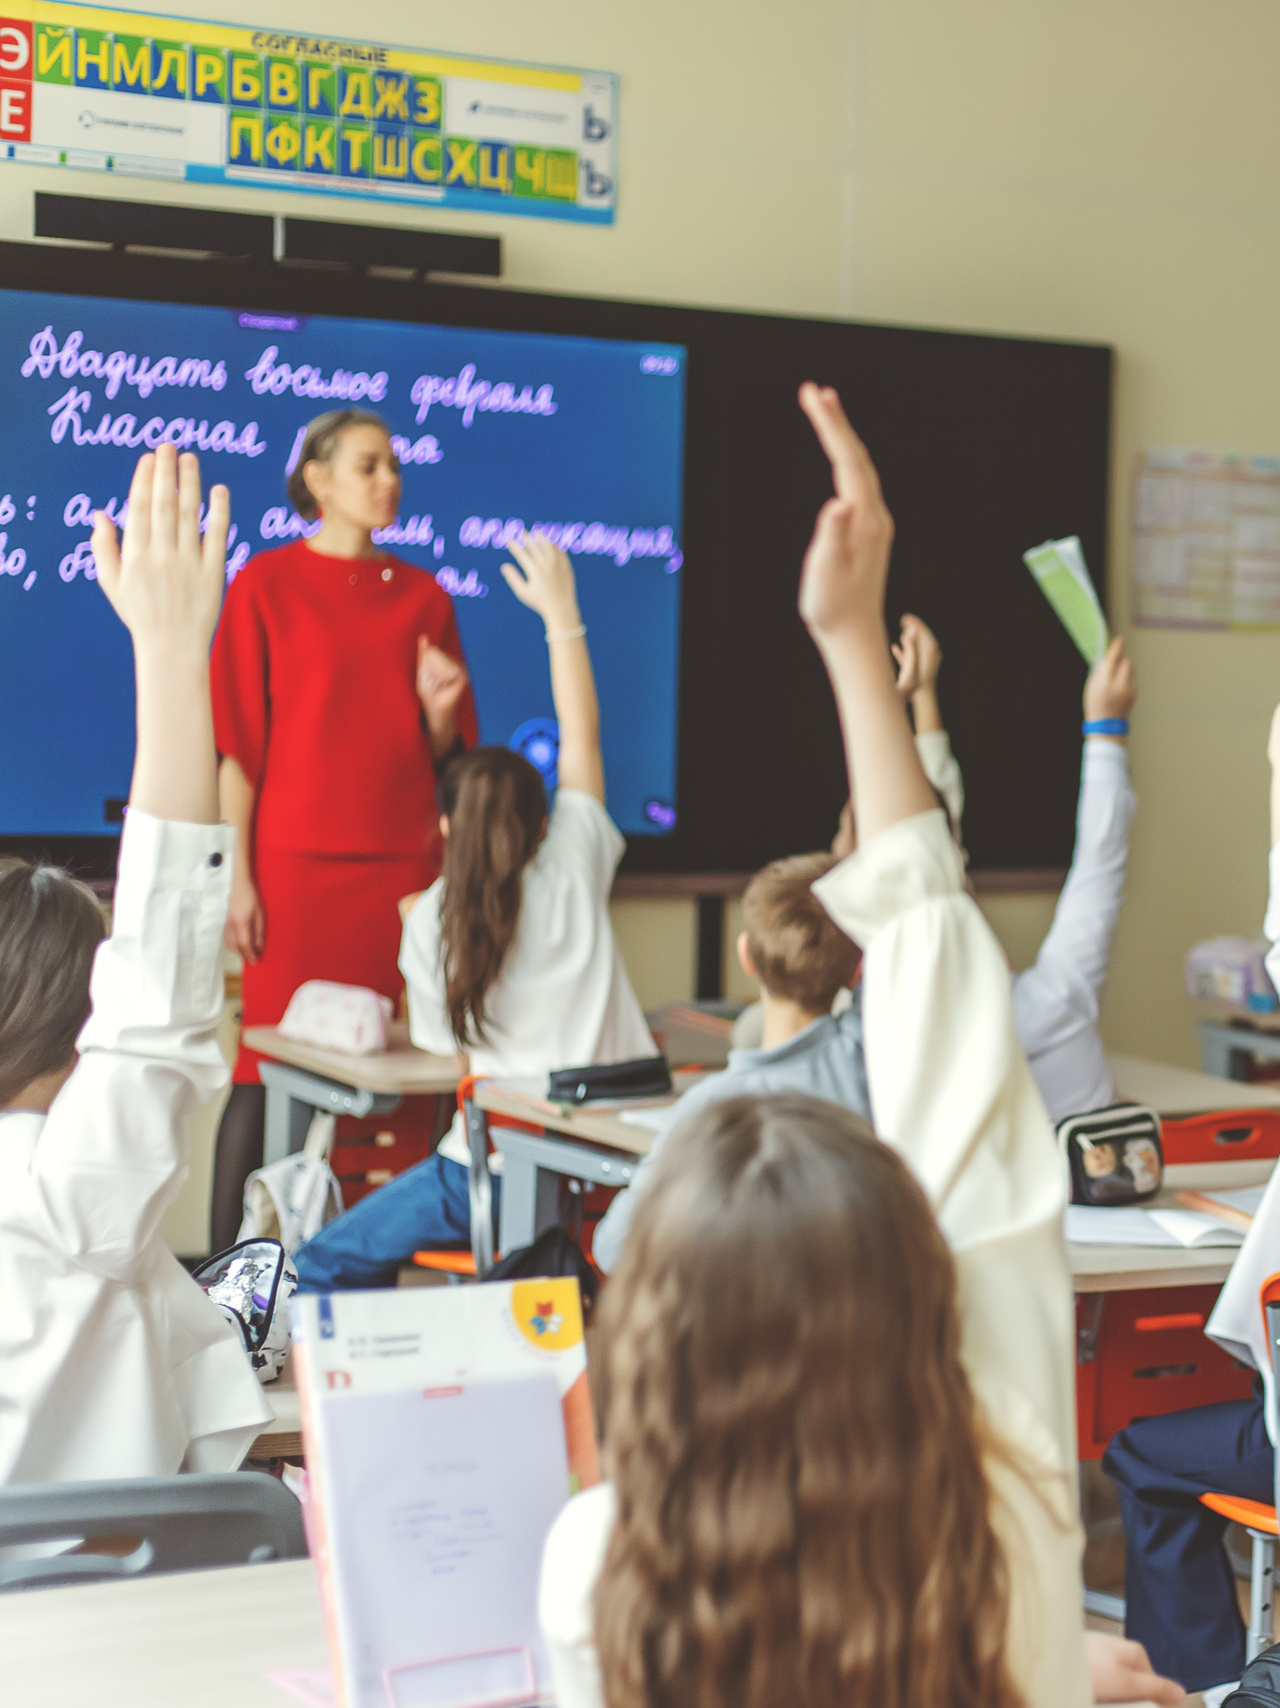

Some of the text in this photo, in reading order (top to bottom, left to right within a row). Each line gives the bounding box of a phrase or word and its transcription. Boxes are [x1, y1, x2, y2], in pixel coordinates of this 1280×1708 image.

[20, 324, 558, 428] Двадцать восьмое февраля
[47, 386, 267, 458] Классная
